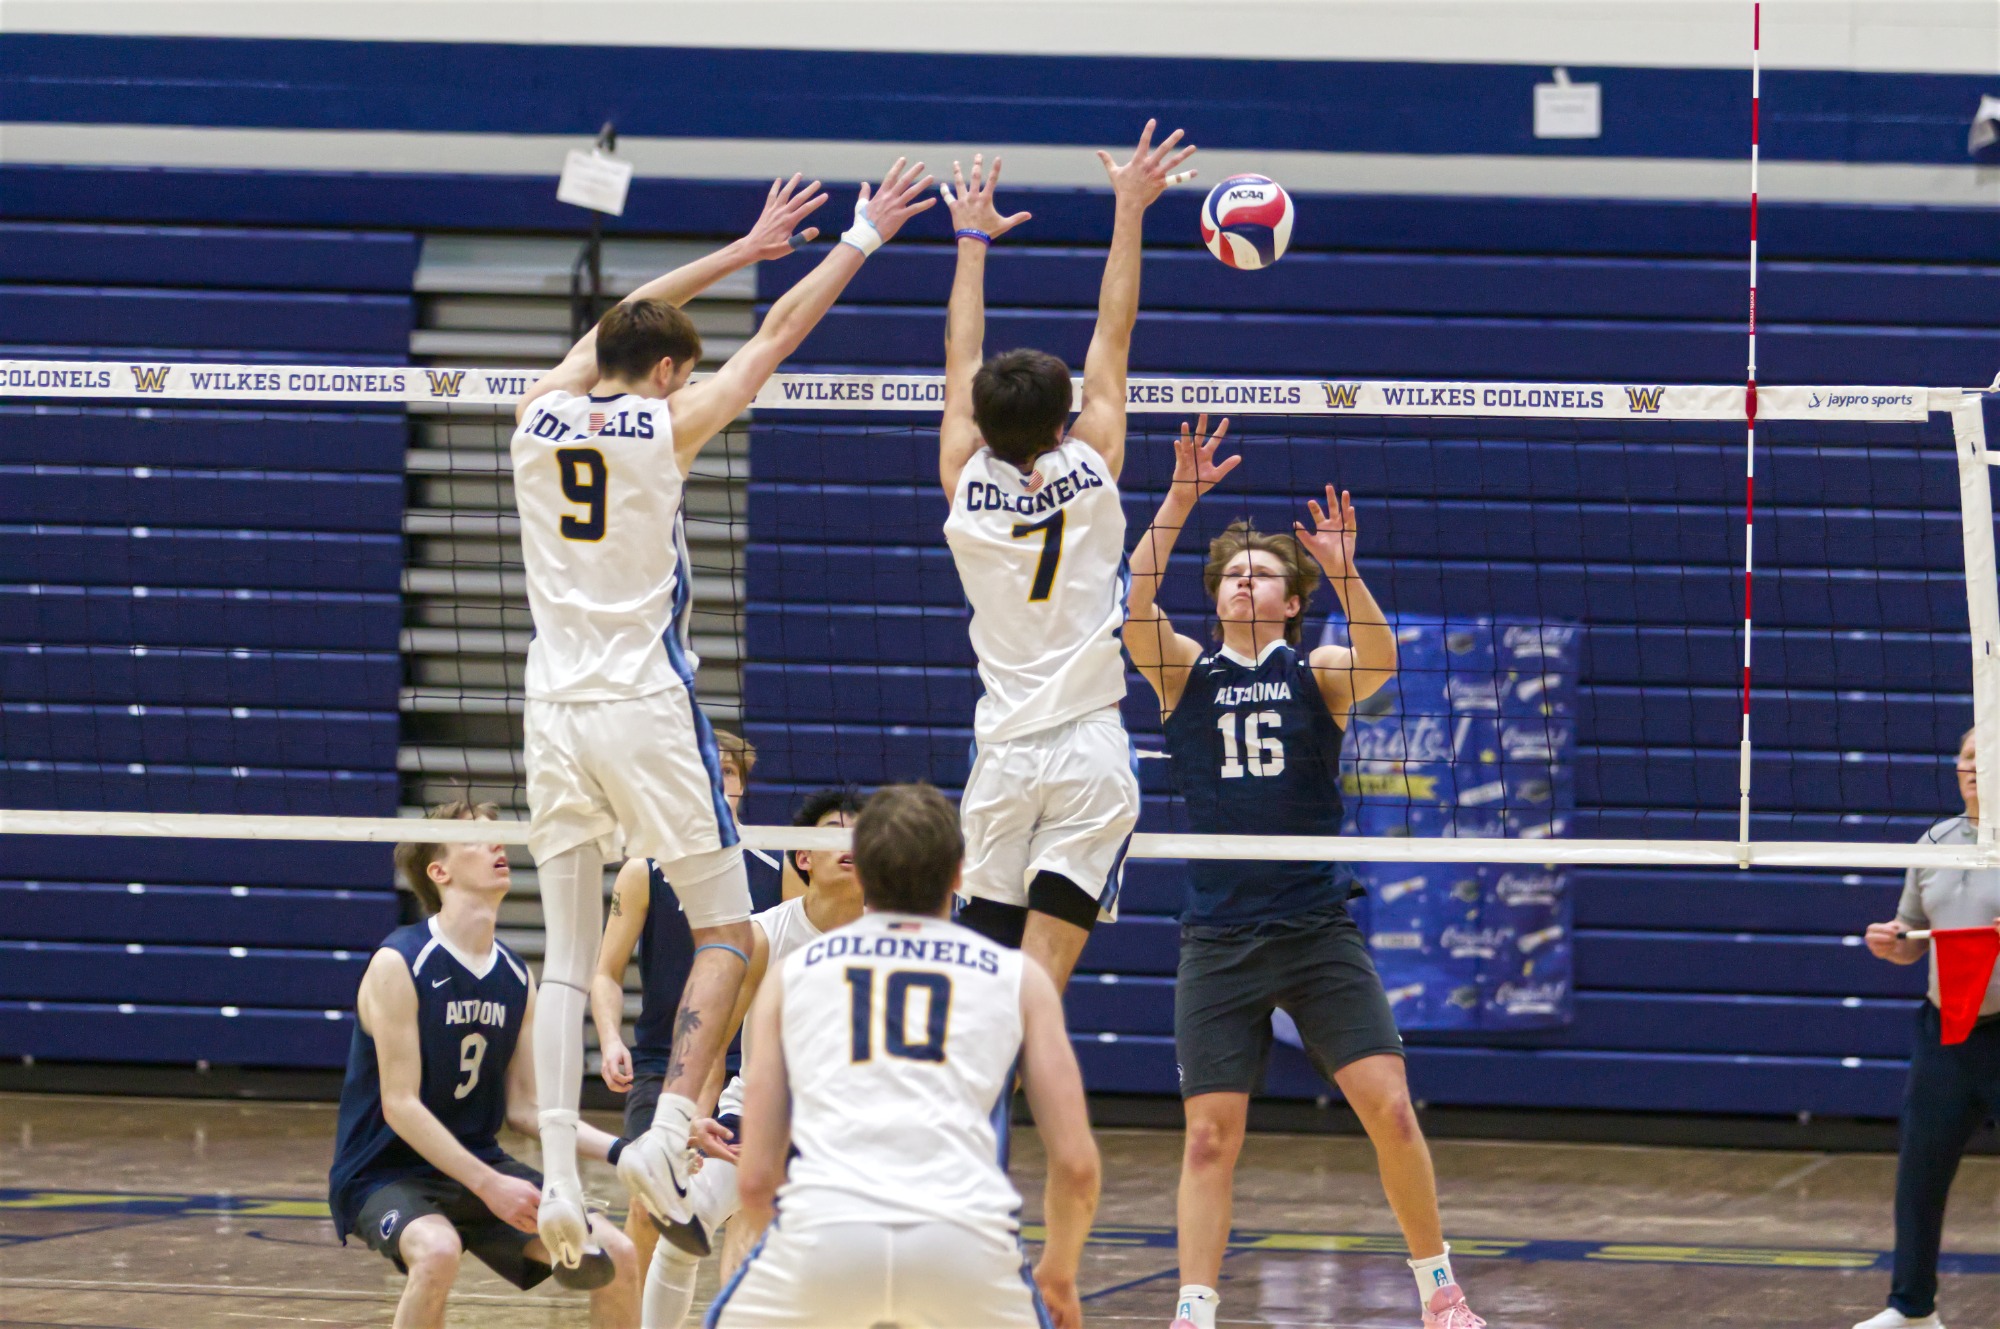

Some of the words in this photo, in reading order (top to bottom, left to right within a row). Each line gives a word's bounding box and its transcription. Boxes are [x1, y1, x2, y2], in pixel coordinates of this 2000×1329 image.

[1229, 190, 1264, 200] NCAA
[190, 372, 281, 391] WILKES
[288, 374, 405, 392] COLONELS
[782, 382, 874, 400] WILKES
[882, 383, 946, 401] COLO
[1181, 386, 1301, 404] COLONELS
[1382, 387, 1475, 407] WILKES
[1483, 389, 1604, 409] COLONELS
[1827, 393, 1869, 407] jaypro
[1871, 395, 1913, 407] sports
[555, 447, 609, 542] 9
[966, 461, 1103, 516] COLONELS
[1010, 507, 1066, 603] 7
[1217, 710, 1285, 779] 16
[804, 935, 999, 976] COLONELS
[842, 965, 954, 1064] 10
[454, 1032, 488, 1100] 9
